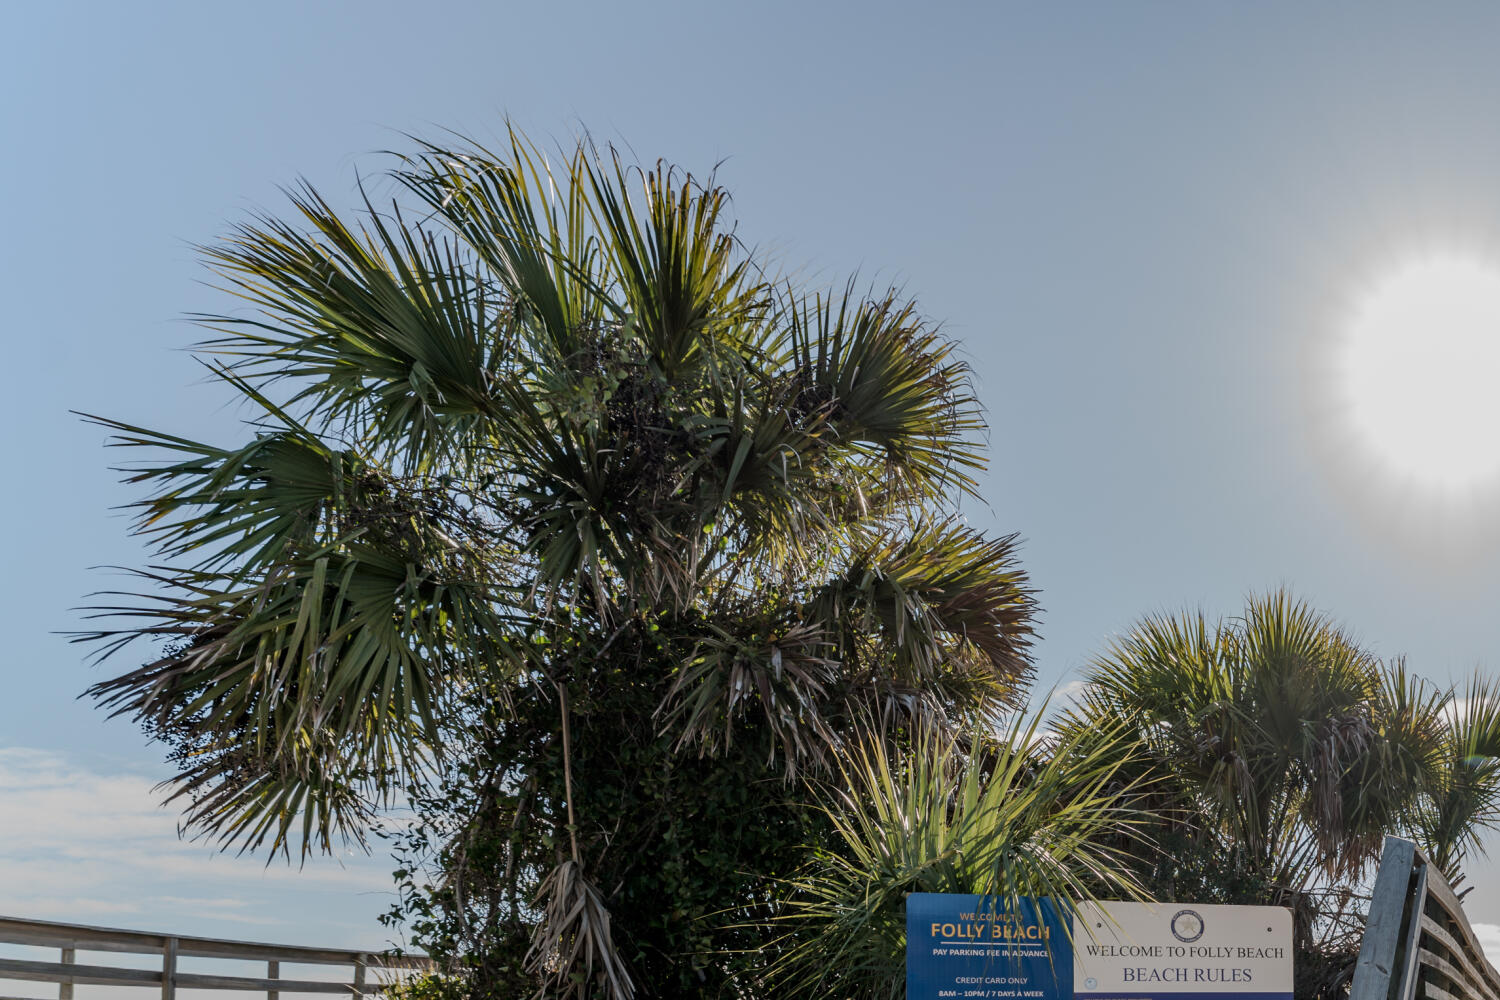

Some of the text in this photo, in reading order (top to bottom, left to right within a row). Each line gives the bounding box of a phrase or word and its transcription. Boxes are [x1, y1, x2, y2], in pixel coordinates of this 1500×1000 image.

[931, 923, 1051, 939] FOLLY BEACH
[949, 949, 985, 957] PARKING
[986, 949, 1000, 957] FEE
[1001, 949, 1010, 957] IN
[1012, 949, 1050, 958] ADVANCE
[1086, 945, 1284, 959] WELCOME TO FOLLY BEACH
[1008, 977, 1028, 985] ONLY
[1123, 967, 1252, 982] BEACH RULES
